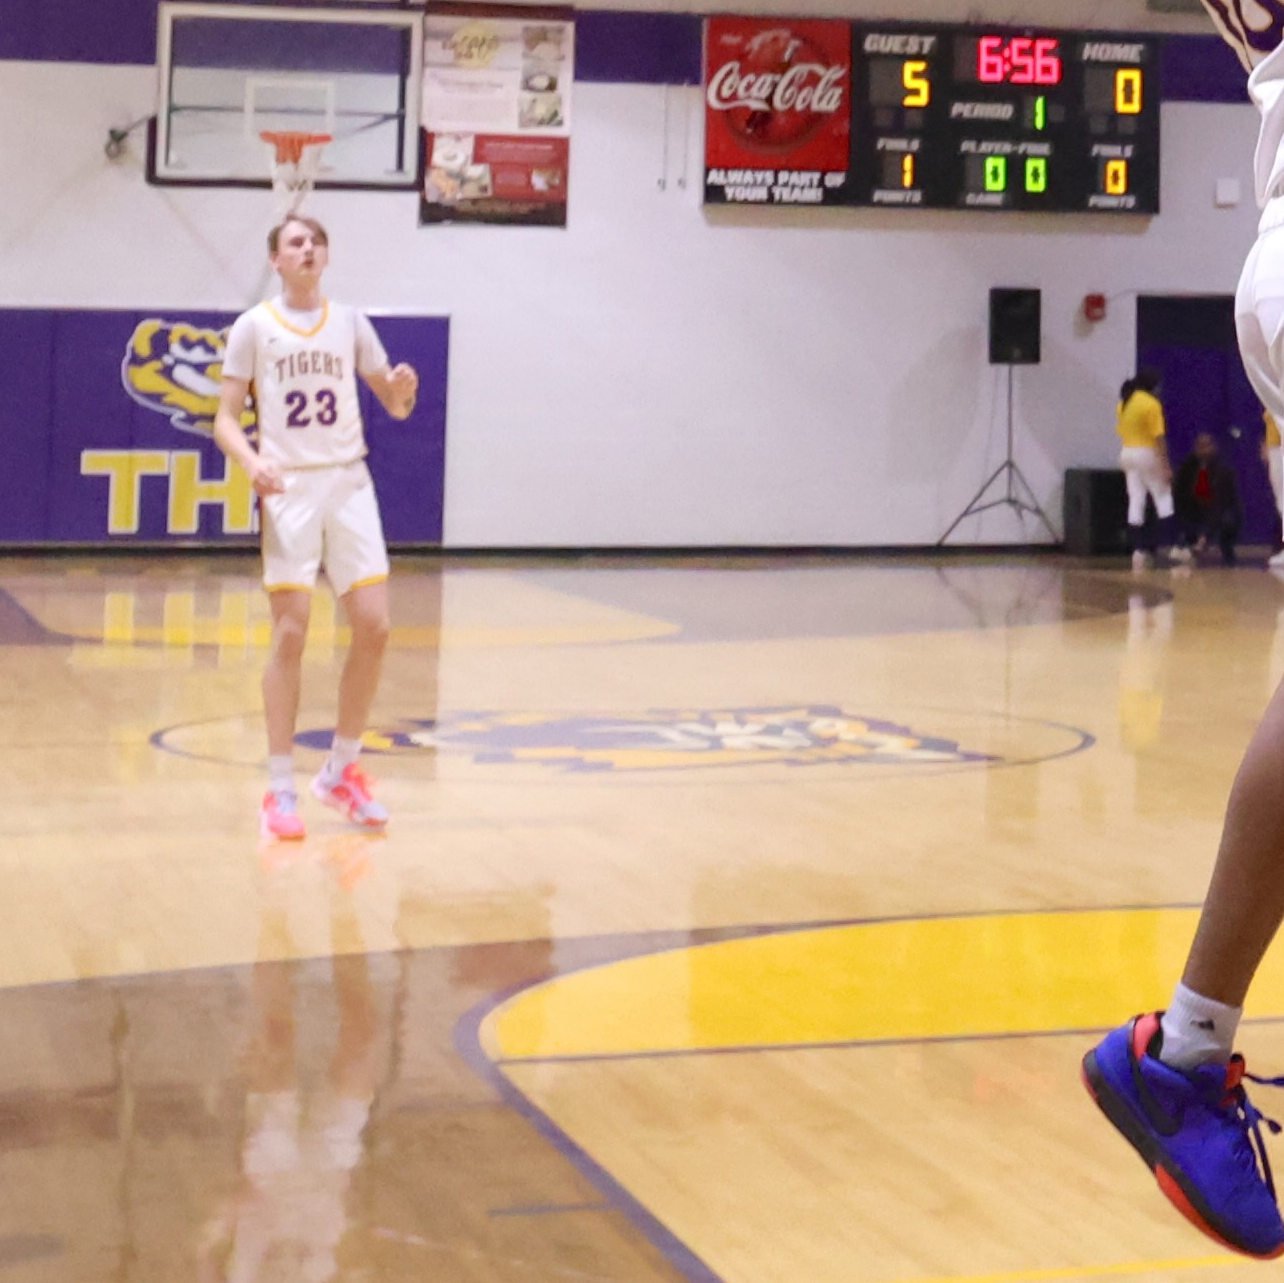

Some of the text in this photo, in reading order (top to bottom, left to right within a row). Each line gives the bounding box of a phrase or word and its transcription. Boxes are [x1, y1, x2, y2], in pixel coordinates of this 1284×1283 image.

[863, 33, 937, 55] GUEST
[977, 35, 1062, 85] 6:56
[1082, 42, 1145, 63] HOME
[902, 59, 931, 108] 5
[1115, 68, 1143, 114] 0
[951, 102, 1014, 120] PERIOD
[1033, 95, 1046, 131] 1
[707, 169, 847, 189] ALWAYS PART OF
[902, 153, 915, 189] 1
[985, 156, 1047, 194] 0 0
[1106, 159, 1128, 196] 0
[725, 186, 769, 203] YOUR
[274, 349, 344, 384] TIGERS
[284, 389, 339, 429] 23
[80, 449, 261, 535] TH
